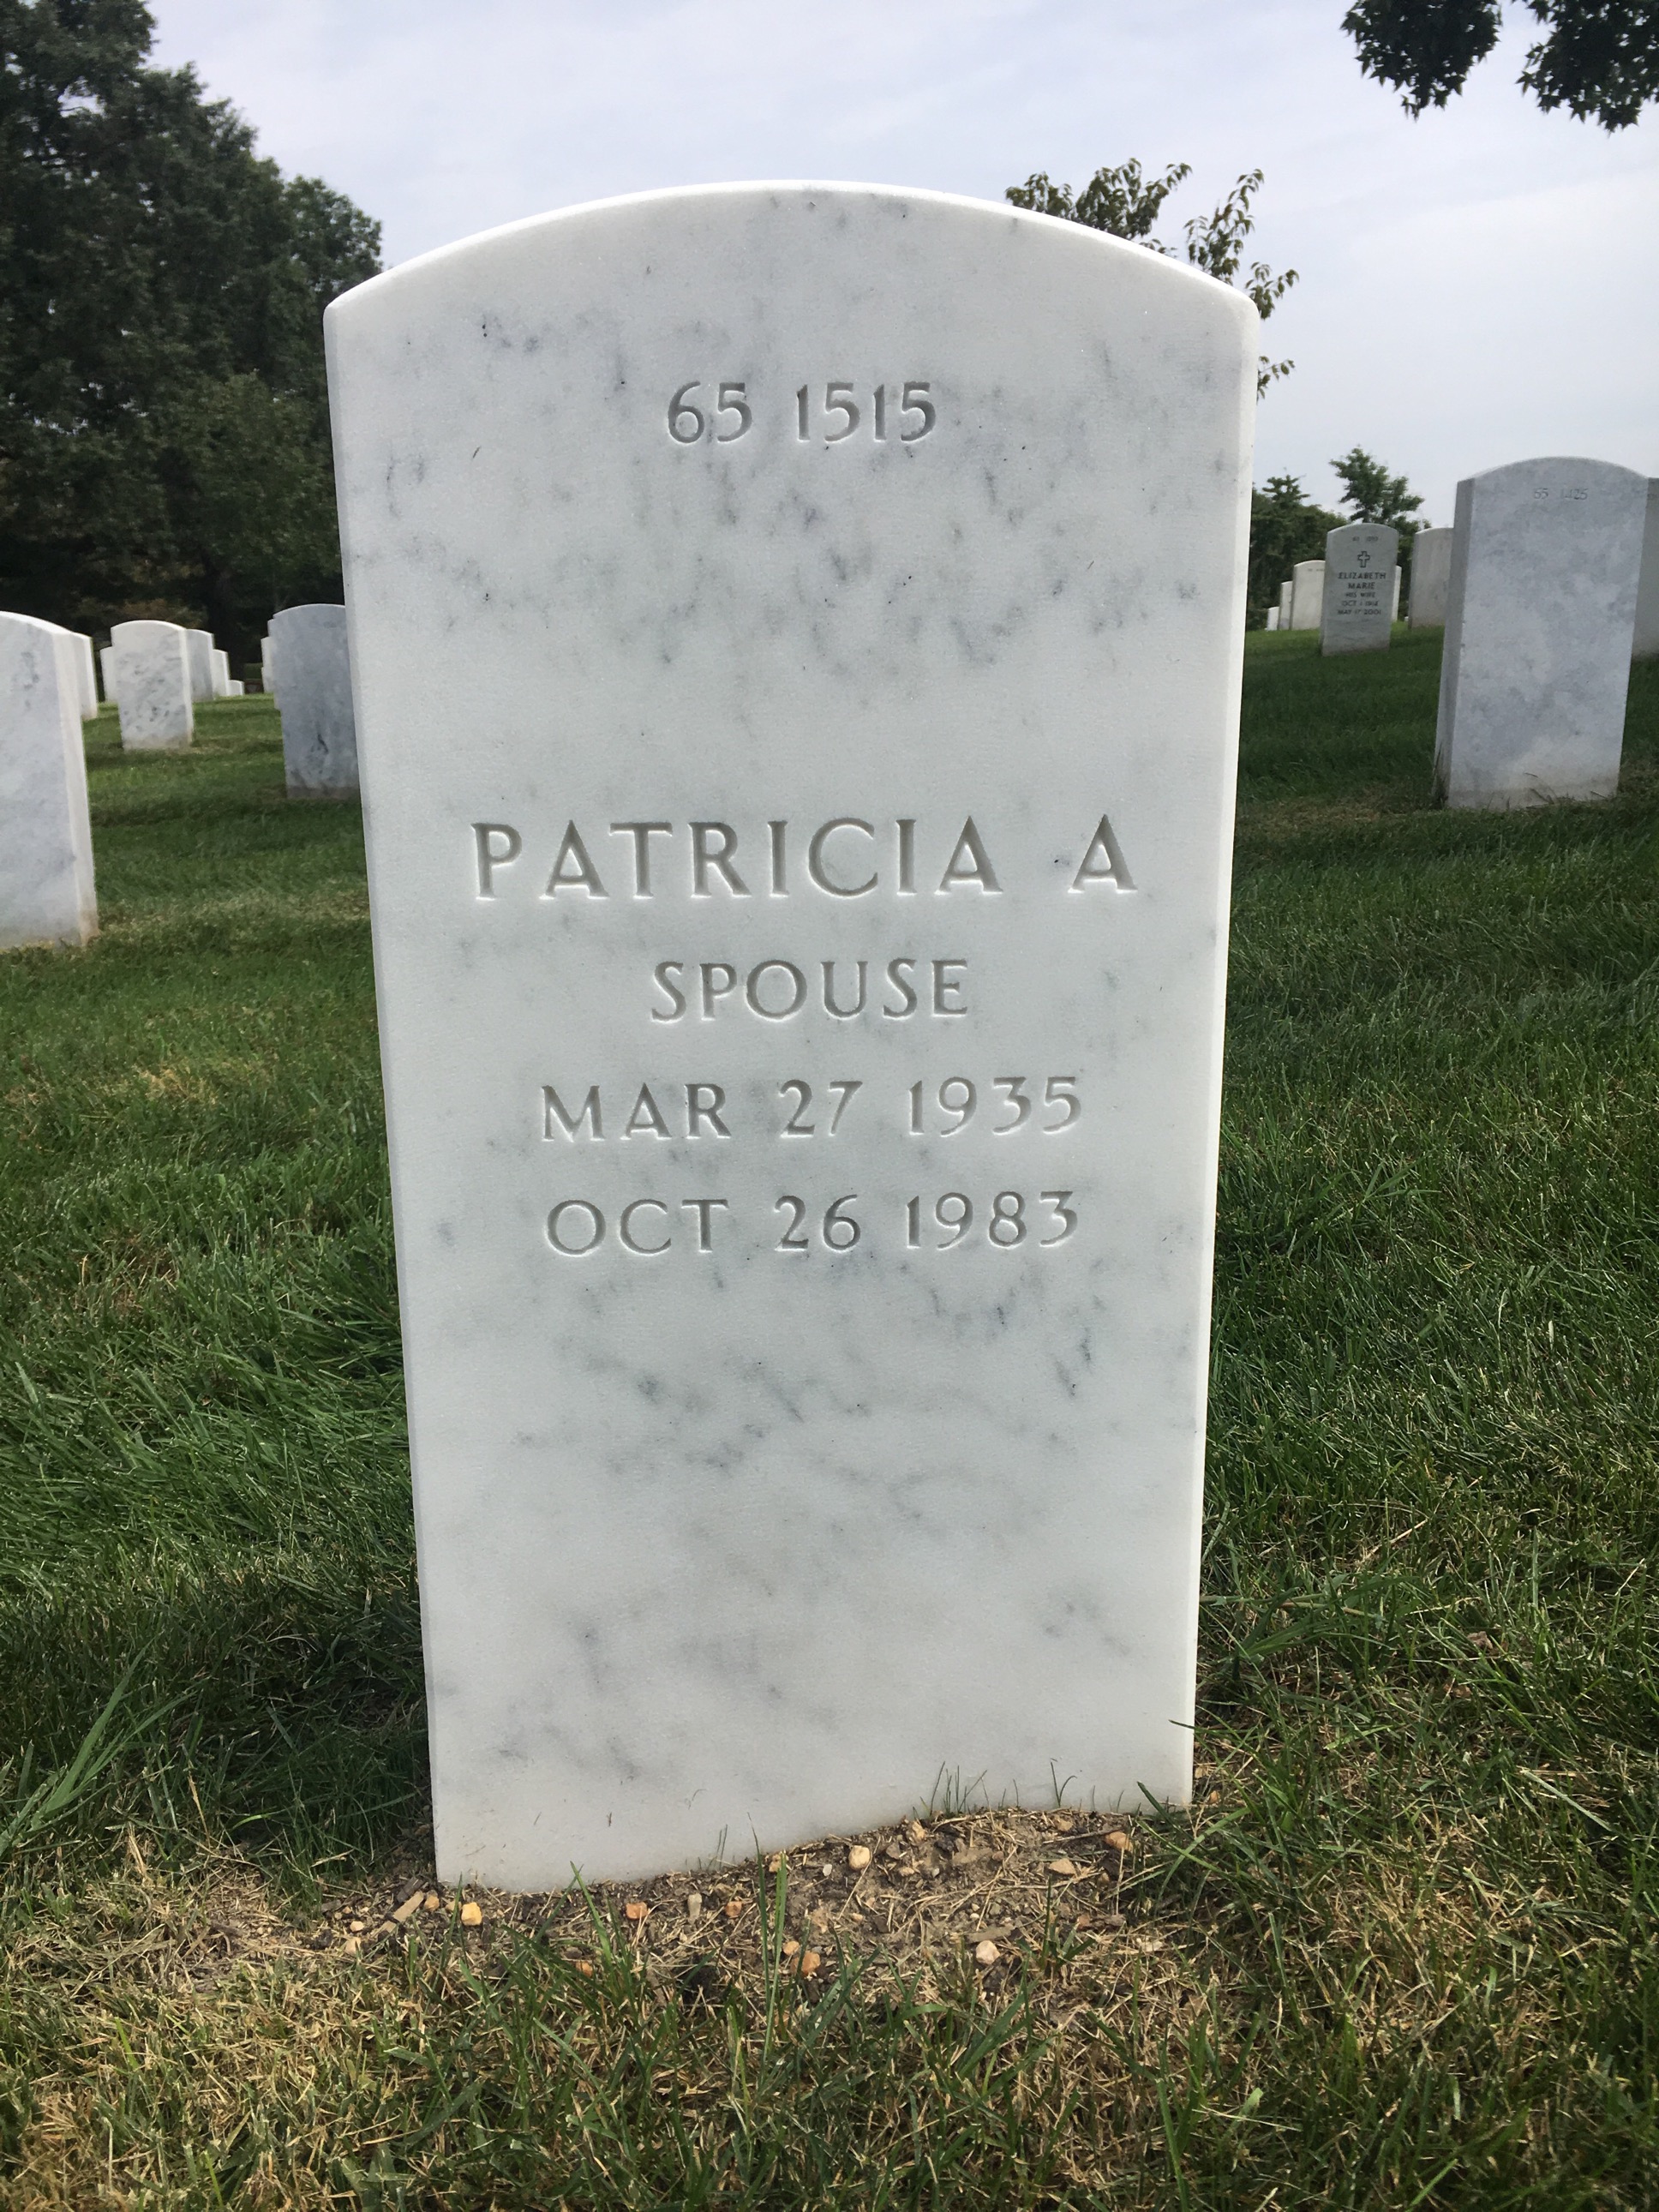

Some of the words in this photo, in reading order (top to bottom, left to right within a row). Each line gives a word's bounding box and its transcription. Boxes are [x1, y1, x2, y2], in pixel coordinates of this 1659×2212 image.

[666, 381, 752, 445] 65
[795, 381, 937, 444] 1515
[470, 816, 1004, 901] PATRICIA
[1067, 812, 1138, 895] A
[650, 958, 969, 1023] SPOUSE
[541, 1082, 733, 1142] MAR
[778, 1078, 864, 1138] 27
[907, 1076, 1083, 1138] 1935
[543, 1198, 729, 1256] OCT
[774, 1194, 861, 1252] 26
[906, 1190, 1078, 1249] 1983
